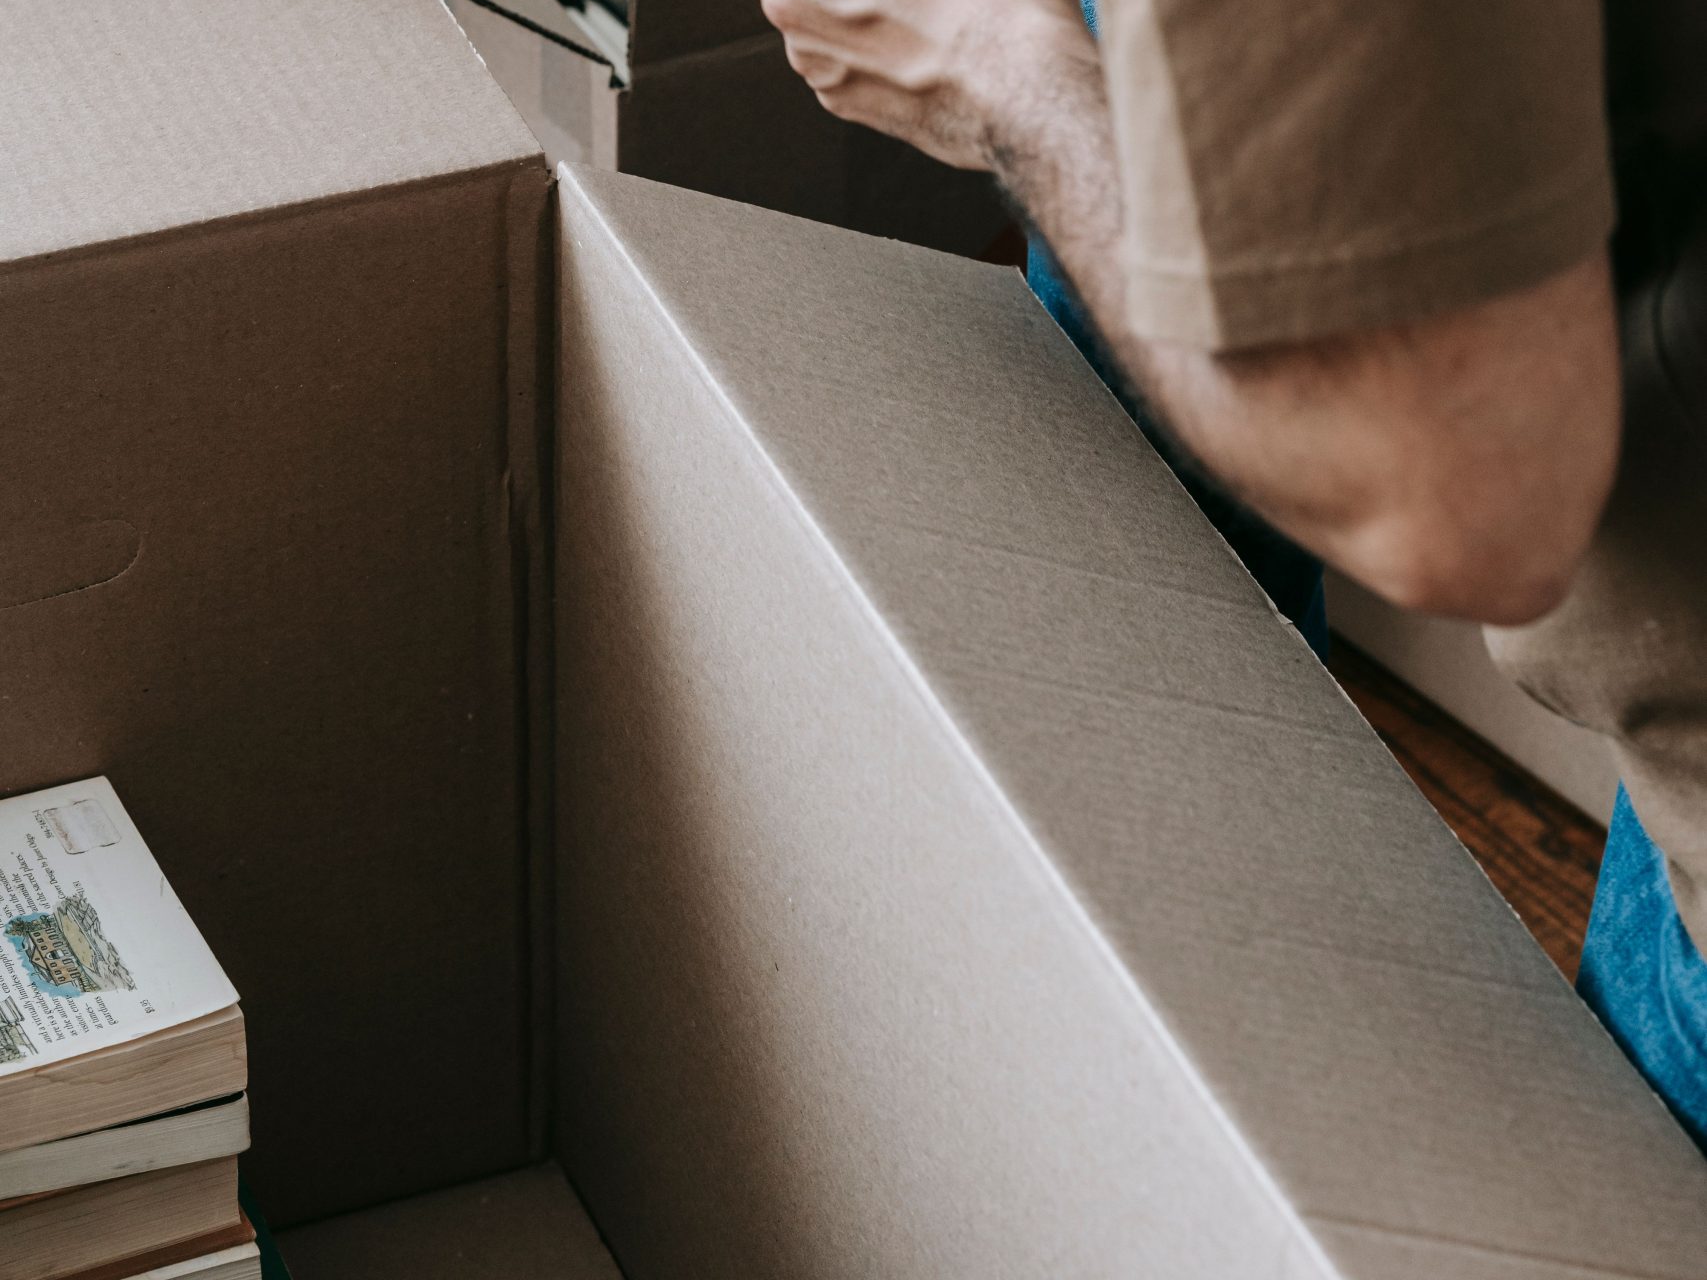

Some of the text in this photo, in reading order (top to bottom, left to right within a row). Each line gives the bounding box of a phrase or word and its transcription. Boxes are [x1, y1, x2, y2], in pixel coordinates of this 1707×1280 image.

[11, 872, 22, 884] the
[22, 871, 41, 892] sacred
[45, 867, 58, 885] Design
[8, 892, 20, 904] the
[15, 882, 39, 913] admonish
[35, 891, 47, 903] the
[54, 884, 66, 900] Cover
[10, 973, 29, 1001] limitless
[28, 981, 54, 1015] guidebook
[22, 1000, 43, 1026] virtually
[51, 997, 68, 1019] author
[94, 995, 118, 1026] guardians
[52, 1026, 66, 1041] here
[62, 1019, 74, 1030] the
[37, 1030, 53, 1044] and
